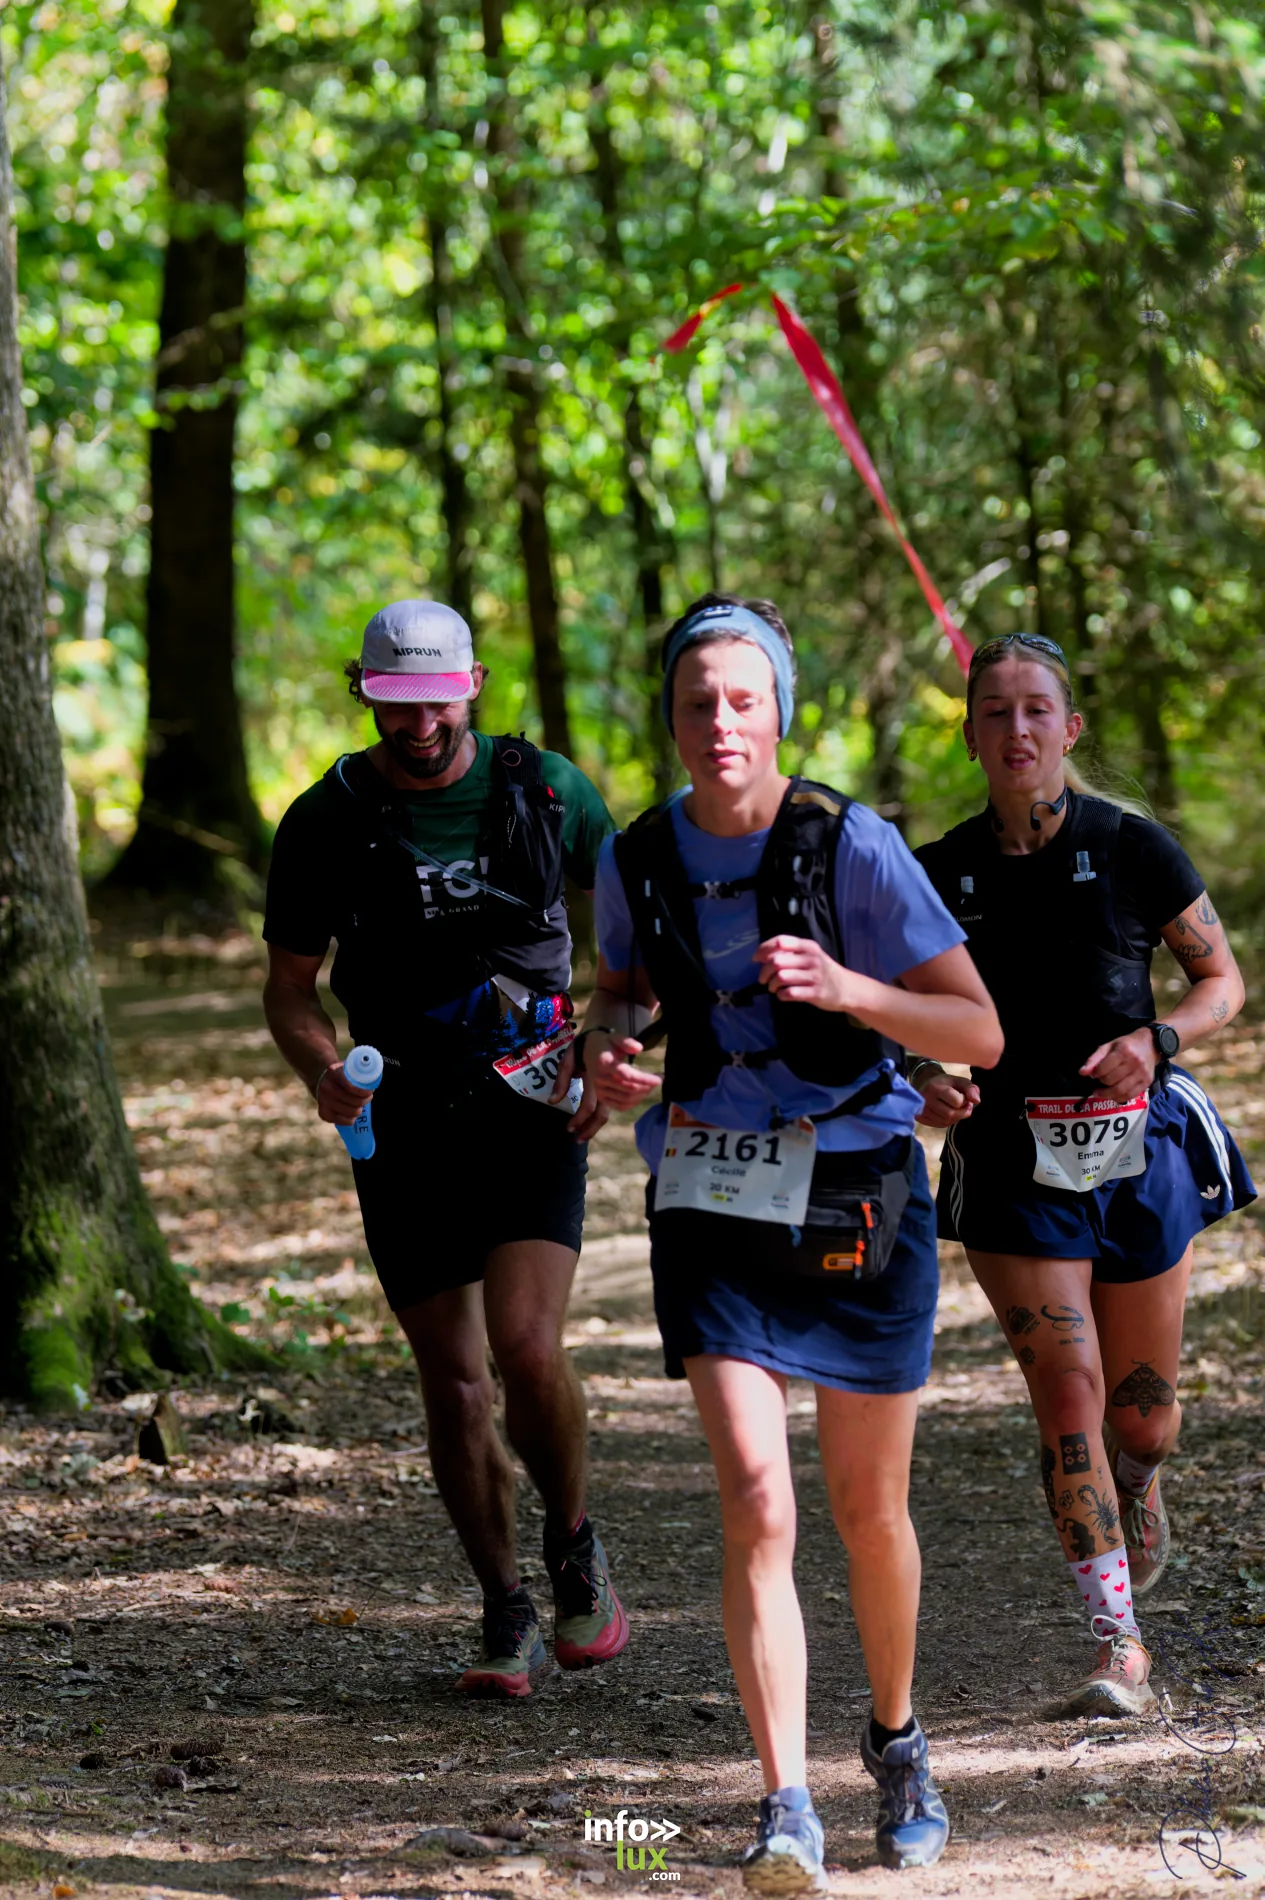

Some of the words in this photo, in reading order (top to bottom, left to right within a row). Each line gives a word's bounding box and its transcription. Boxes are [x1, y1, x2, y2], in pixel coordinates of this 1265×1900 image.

[392, 647, 442, 658] KIPRUN
[523, 1048, 566, 1090] 30
[1038, 1104, 1063, 1114] TRAIL
[1049, 1116, 1130, 1148] 3079
[685, 1131, 783, 1167] 2161
[1078, 1149, 1105, 1160] Emma
[1081, 1167, 1091, 1175] 30
[724, 1185, 740, 1195] KM
